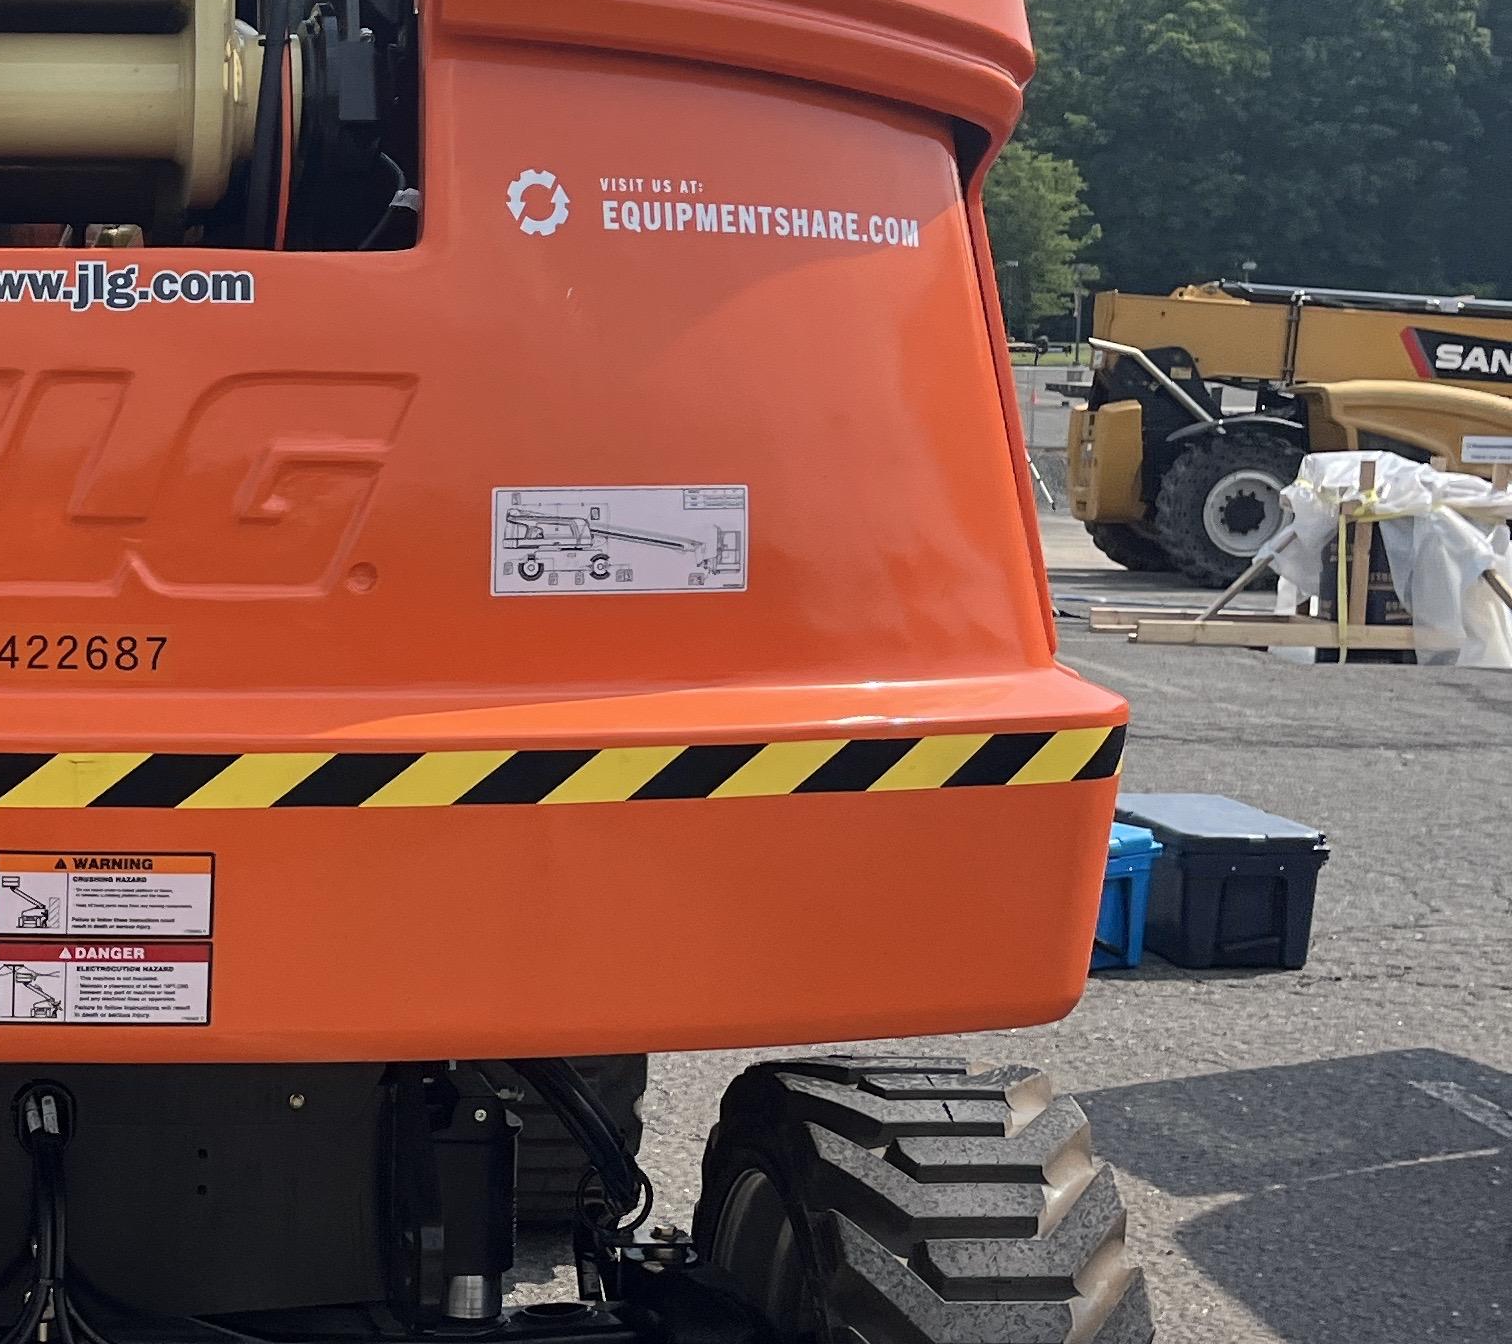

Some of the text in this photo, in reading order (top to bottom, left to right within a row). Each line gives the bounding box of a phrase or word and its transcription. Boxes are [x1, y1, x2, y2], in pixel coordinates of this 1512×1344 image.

[599, 177, 704, 195] VISIT US AT:
[602, 200, 921, 248] EQUIPMENTSHARE.COM
[72, 857, 153, 870] WARNING
[74, 947, 145, 959] DANGER
